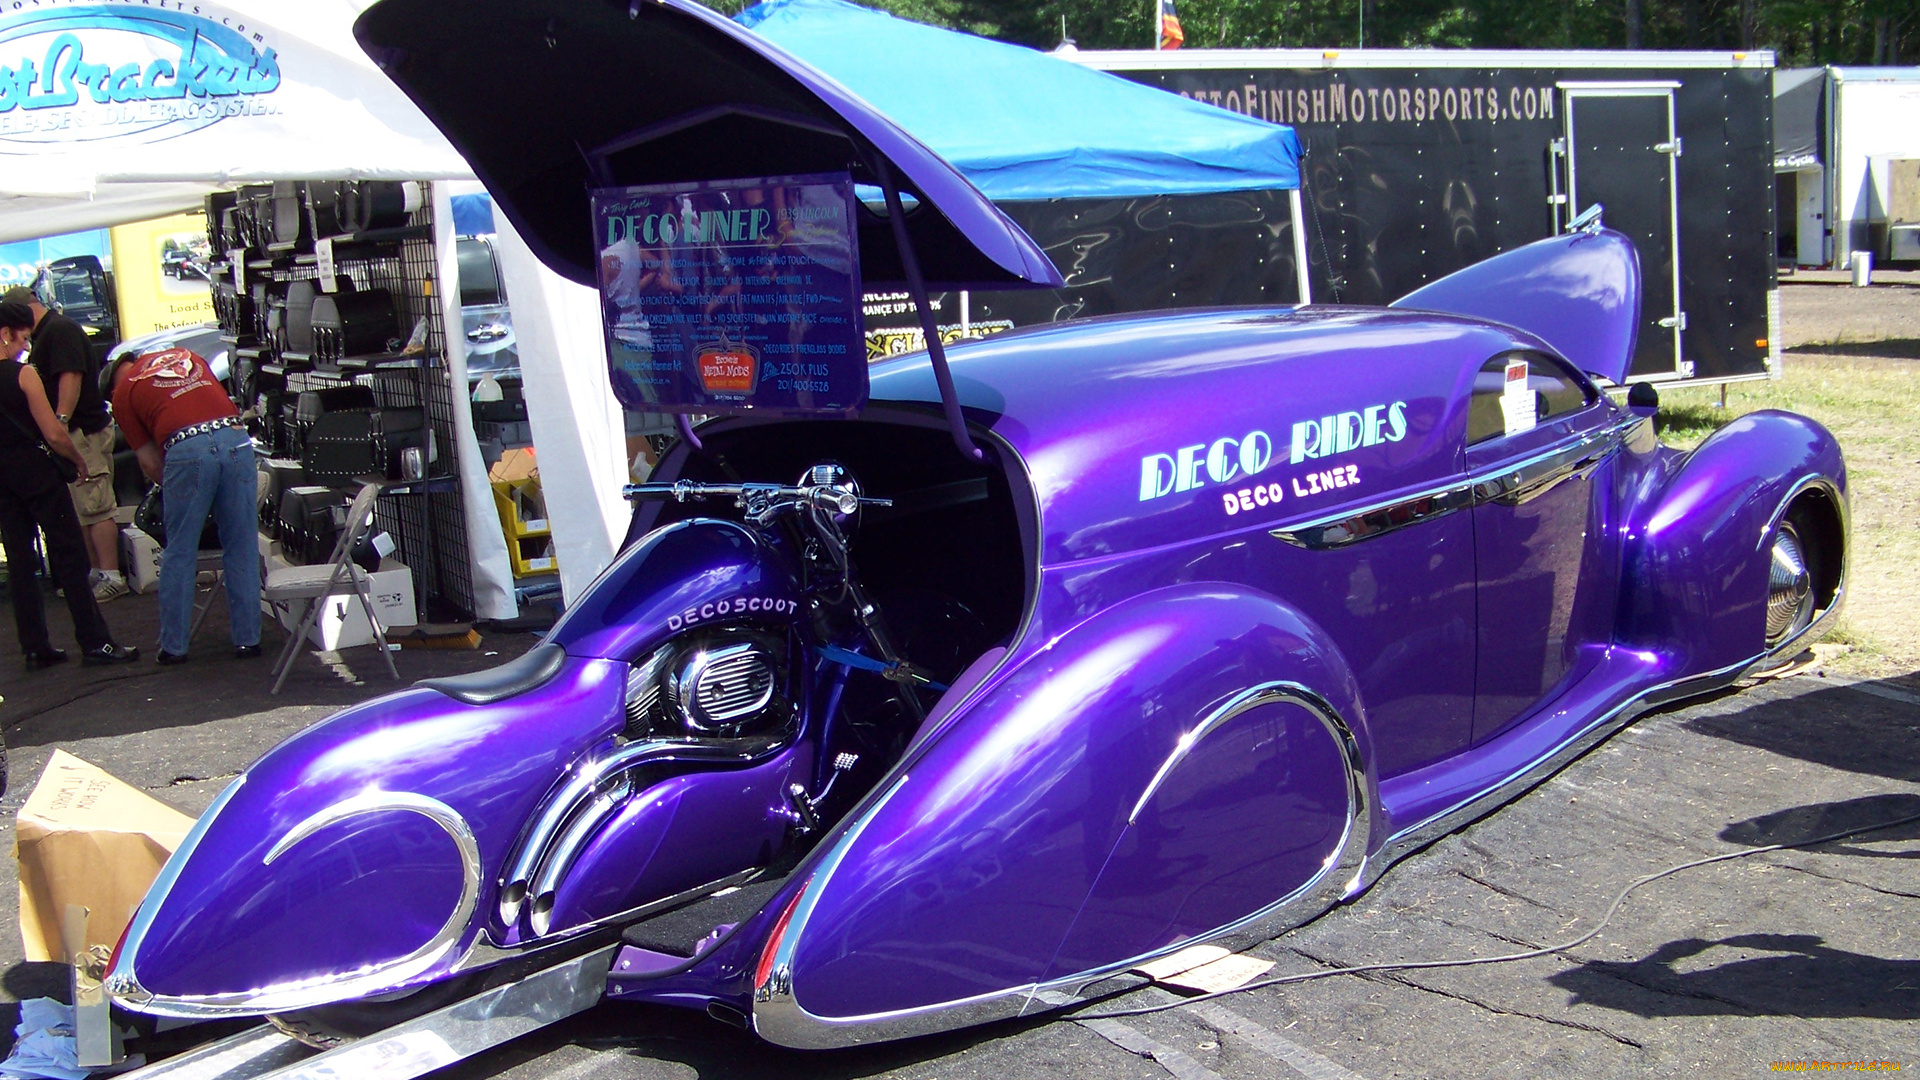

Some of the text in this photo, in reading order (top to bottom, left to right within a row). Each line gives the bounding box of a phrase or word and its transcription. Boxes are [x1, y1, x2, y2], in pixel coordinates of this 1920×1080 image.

[607, 213, 678, 246] DECO
[684, 208, 771, 243] LINER
[170, 302, 199, 313] Load
[893, 303, 907, 313] UP
[808, 363, 829, 376] PLUS
[1139, 400, 1407, 502] DECO RIDES
[1222, 464, 1361, 516] DECO LINER
